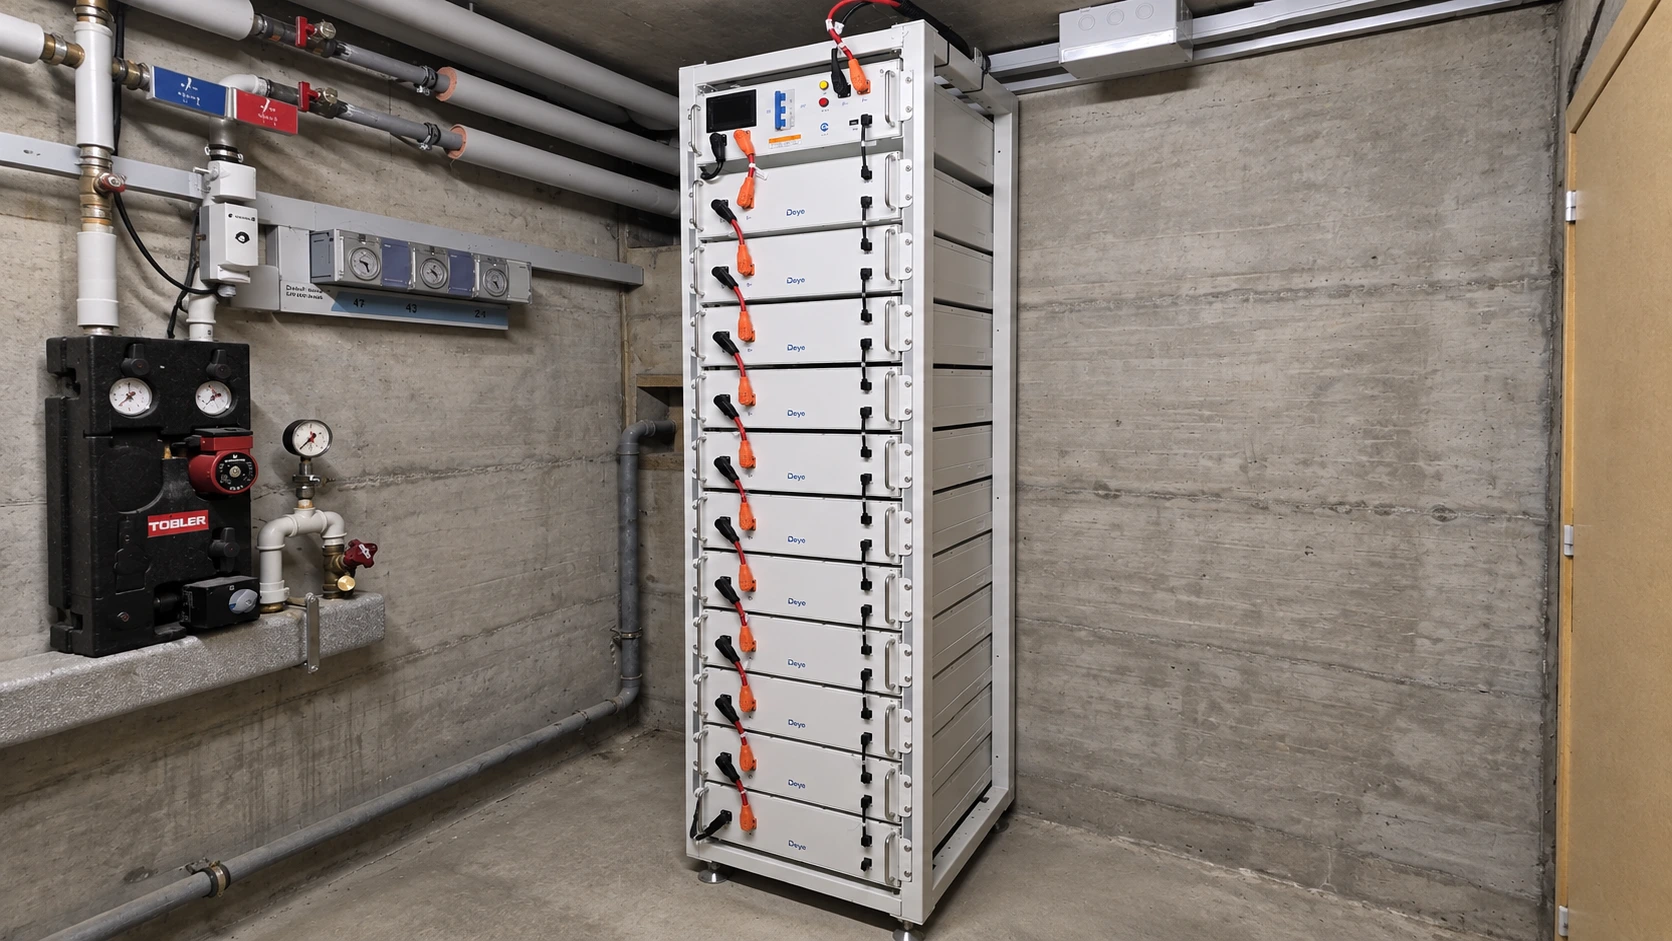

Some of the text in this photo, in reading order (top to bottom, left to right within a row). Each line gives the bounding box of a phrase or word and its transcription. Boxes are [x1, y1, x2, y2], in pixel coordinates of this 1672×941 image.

[353, 298, 365, 308] 47
[405, 303, 418, 314] 43
[148, 515, 206, 532] TOBLER
